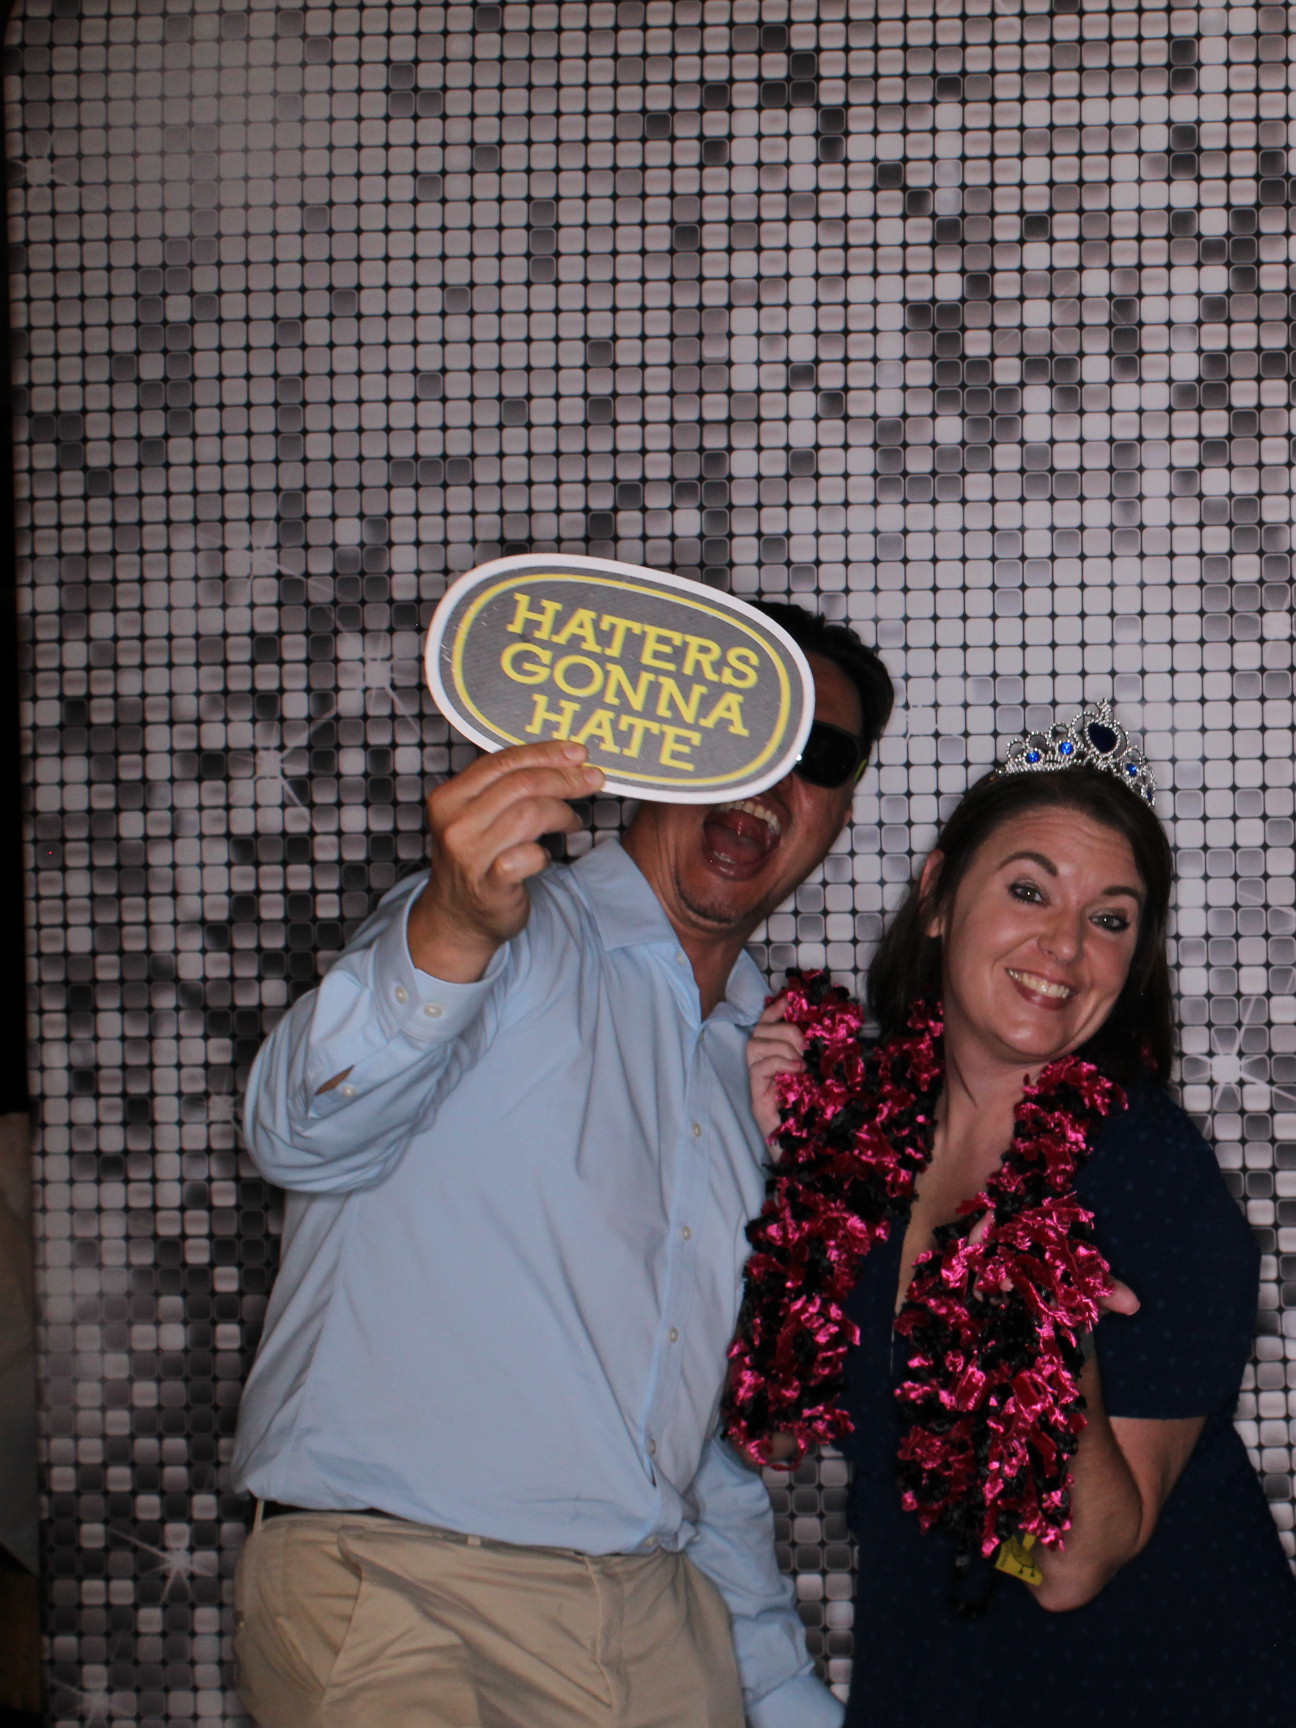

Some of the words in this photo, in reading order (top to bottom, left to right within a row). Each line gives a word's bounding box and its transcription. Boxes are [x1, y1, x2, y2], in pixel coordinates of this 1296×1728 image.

[506, 592, 760, 689] HATERS
[500, 641, 750, 737] GONNA
[524, 693, 702, 772] HATE
